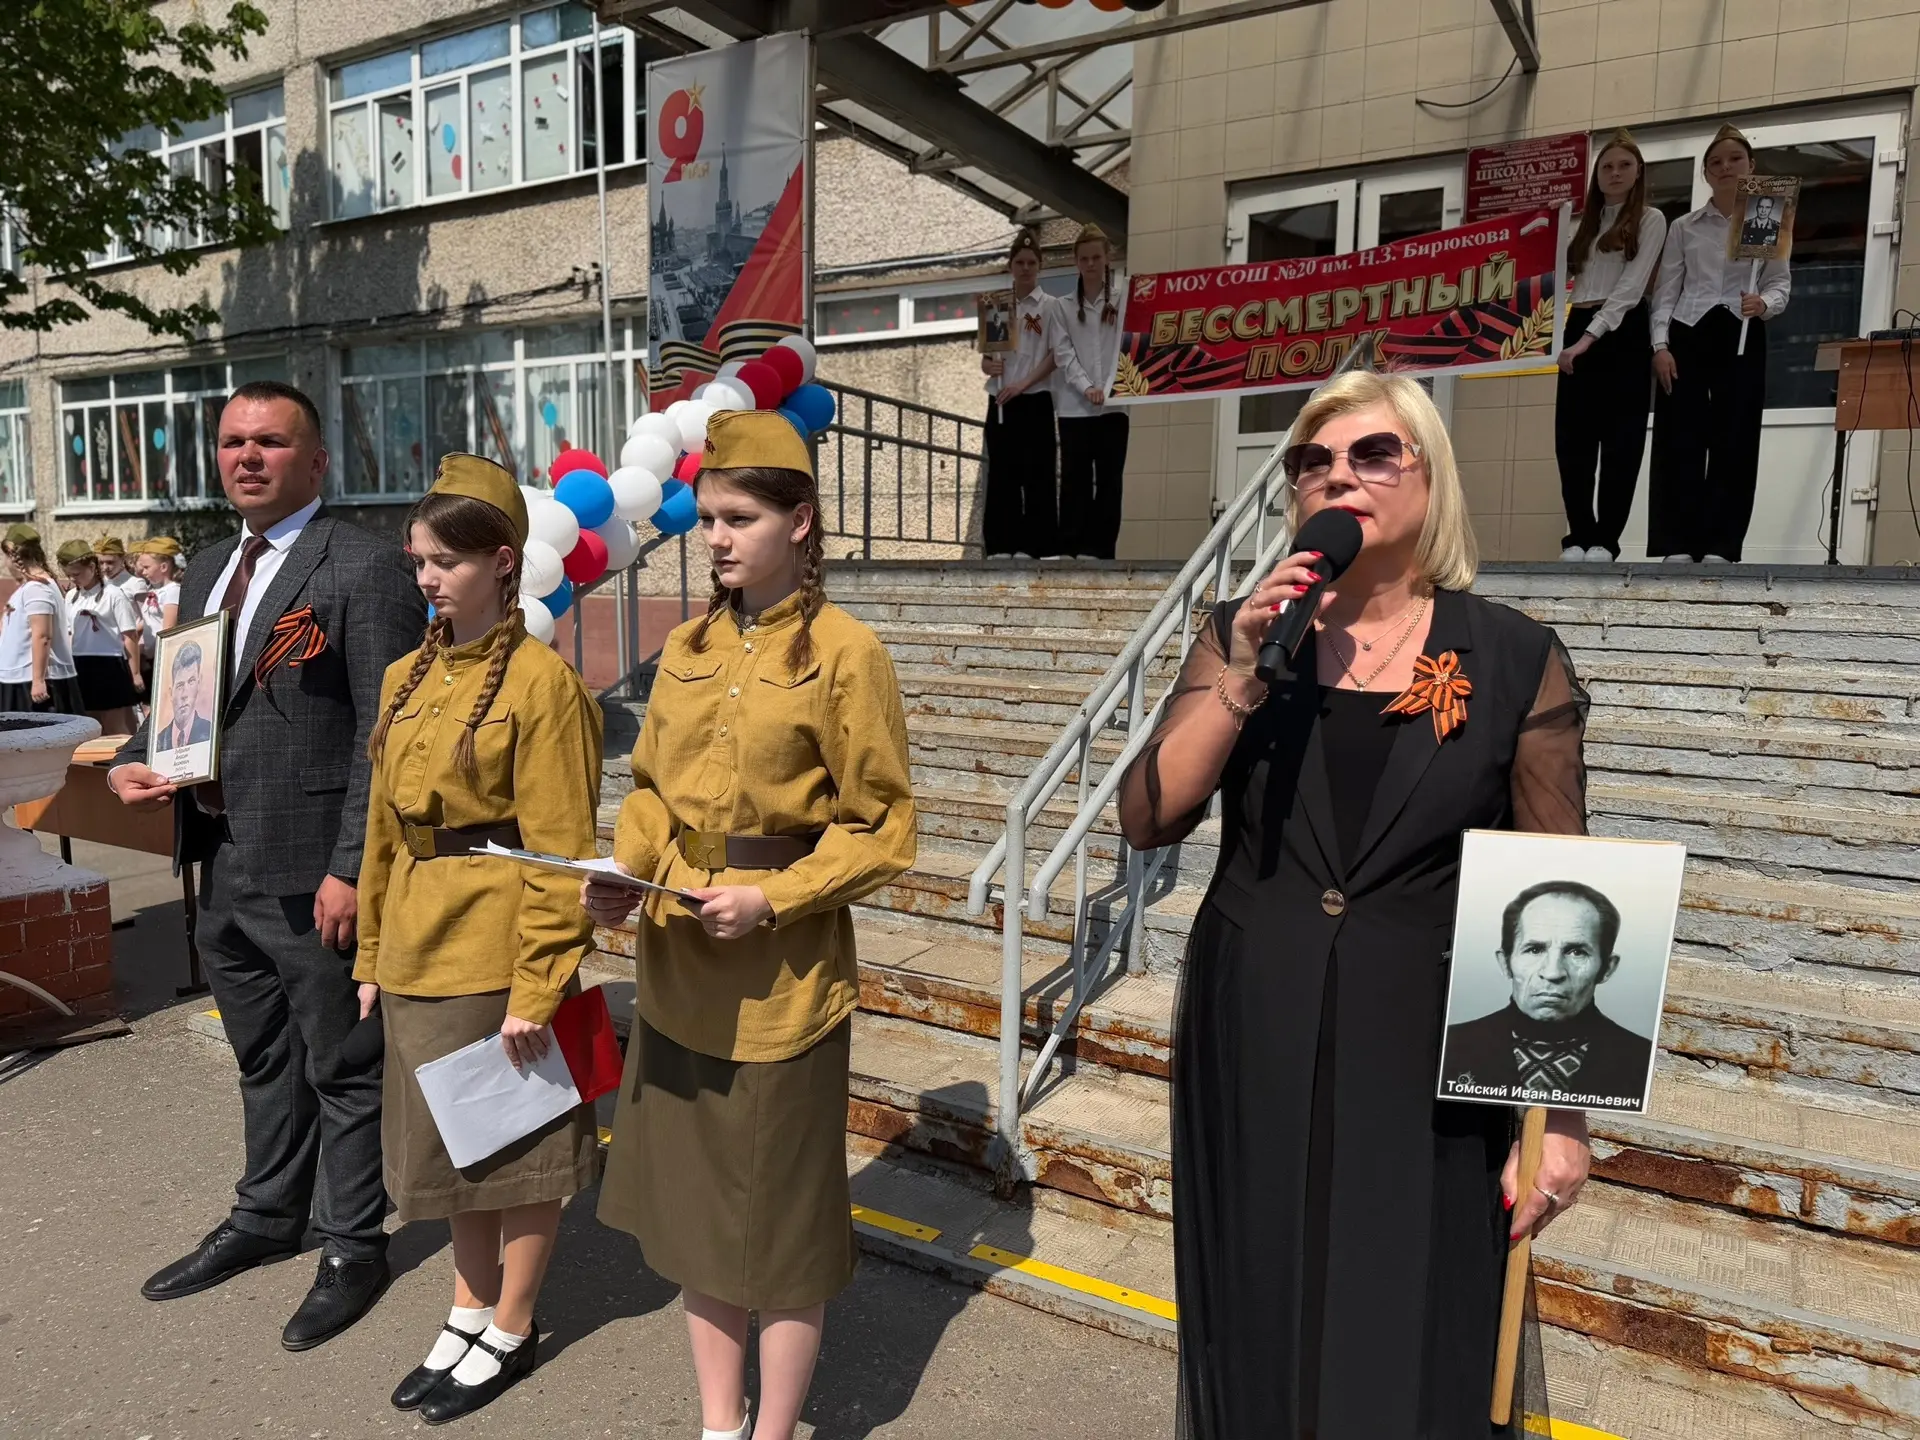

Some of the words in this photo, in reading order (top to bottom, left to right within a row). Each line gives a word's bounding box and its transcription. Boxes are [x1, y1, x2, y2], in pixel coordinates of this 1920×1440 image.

[658, 89, 704, 184] 9
[1475, 162, 1536, 181] ШКОЛА
[1559, 157, 1578, 170] 20
[1549, 183, 1572, 193] 19:00
[1164, 273, 1212, 294] МОУ
[1216, 266, 1270, 287] СОШ
[1274, 260, 1316, 281] №20
[1321, 259, 1352, 274] им.
[1358, 247, 1396, 267] Н.З.
[1402, 228, 1510, 259] Бирюкова
[1149, 251, 1517, 347] БЕССМЕРТНЫЙ
[1245, 328, 1391, 380] ПОЛК
[1447, 1080, 1507, 1098] Томский
[1511, 1086, 1548, 1100] Иван
[1551, 1089, 1640, 1108] Васильевич
